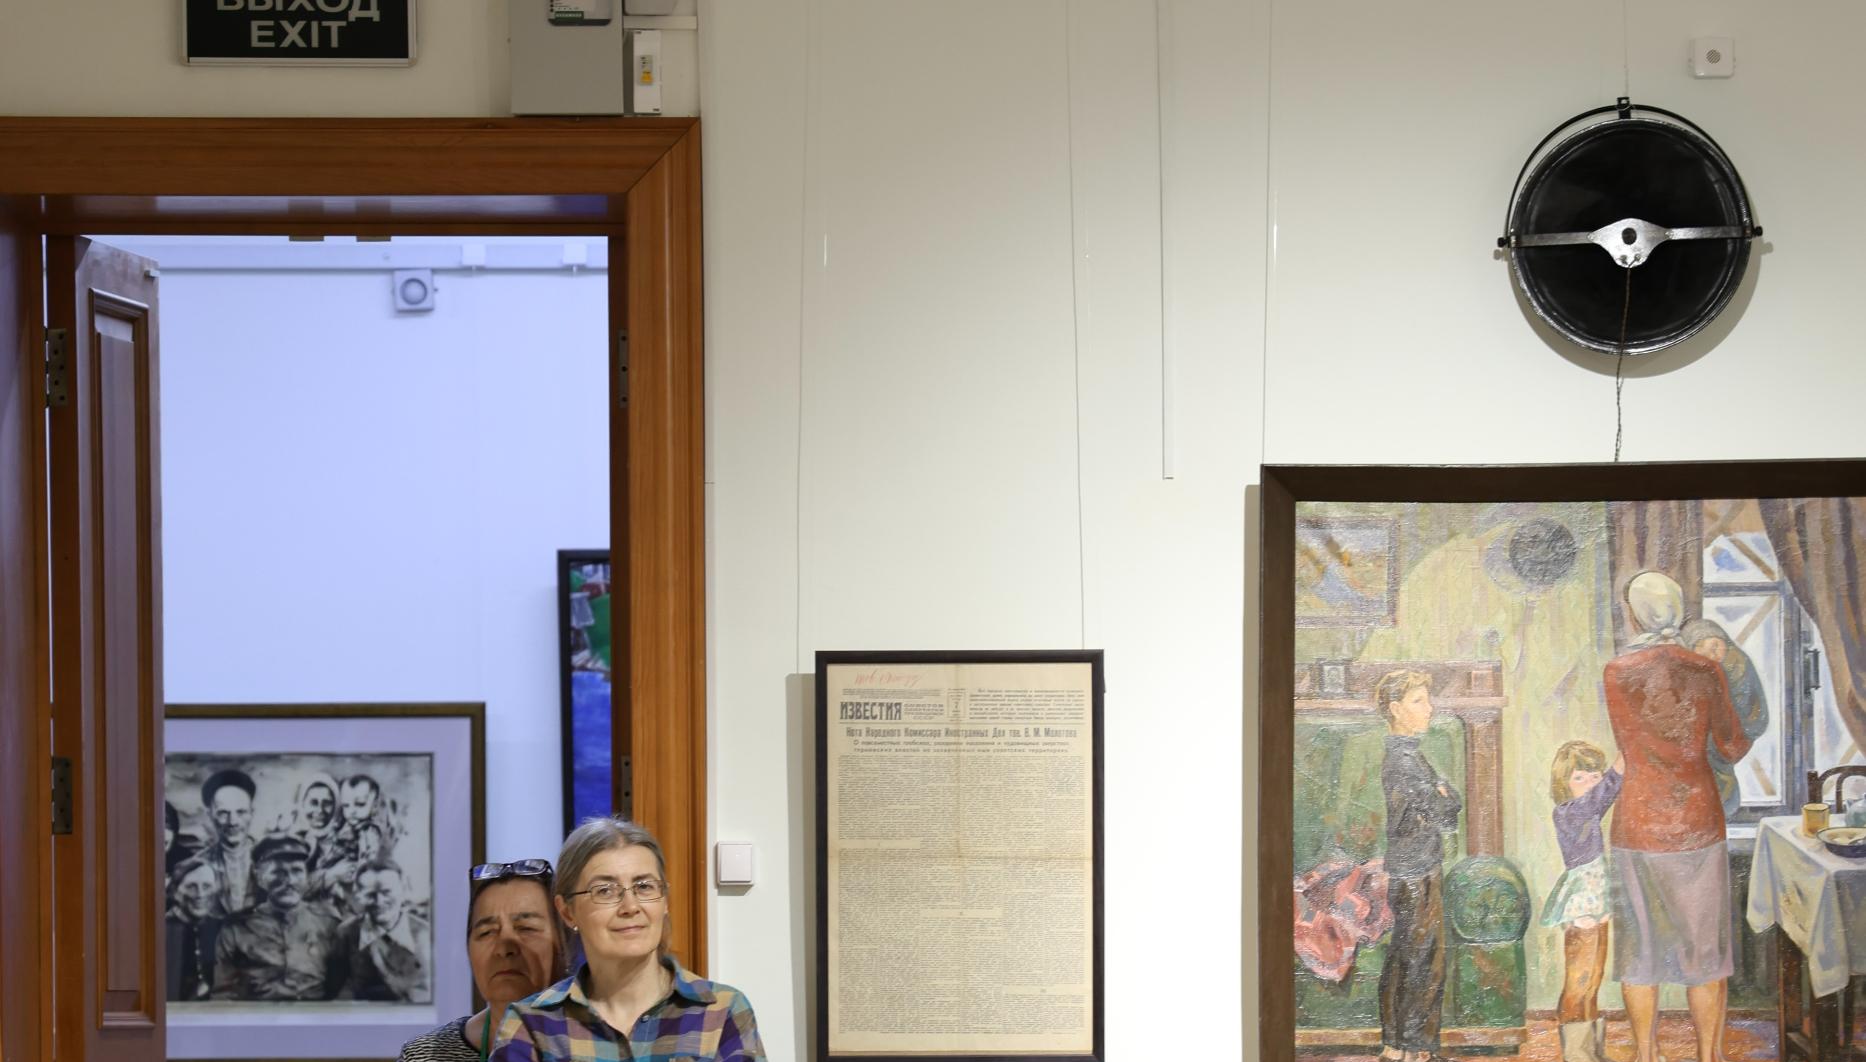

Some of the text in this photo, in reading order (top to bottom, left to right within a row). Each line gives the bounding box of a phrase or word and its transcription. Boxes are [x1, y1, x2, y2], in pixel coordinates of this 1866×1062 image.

[251, 20, 347, 48] EXIT
[839, 701, 903, 721] ИЗВЕСТИЯ
[846, 727, 863, 737] Нота
[865, 727, 901, 738] Народного
[904, 727, 942, 738] Комиссара
